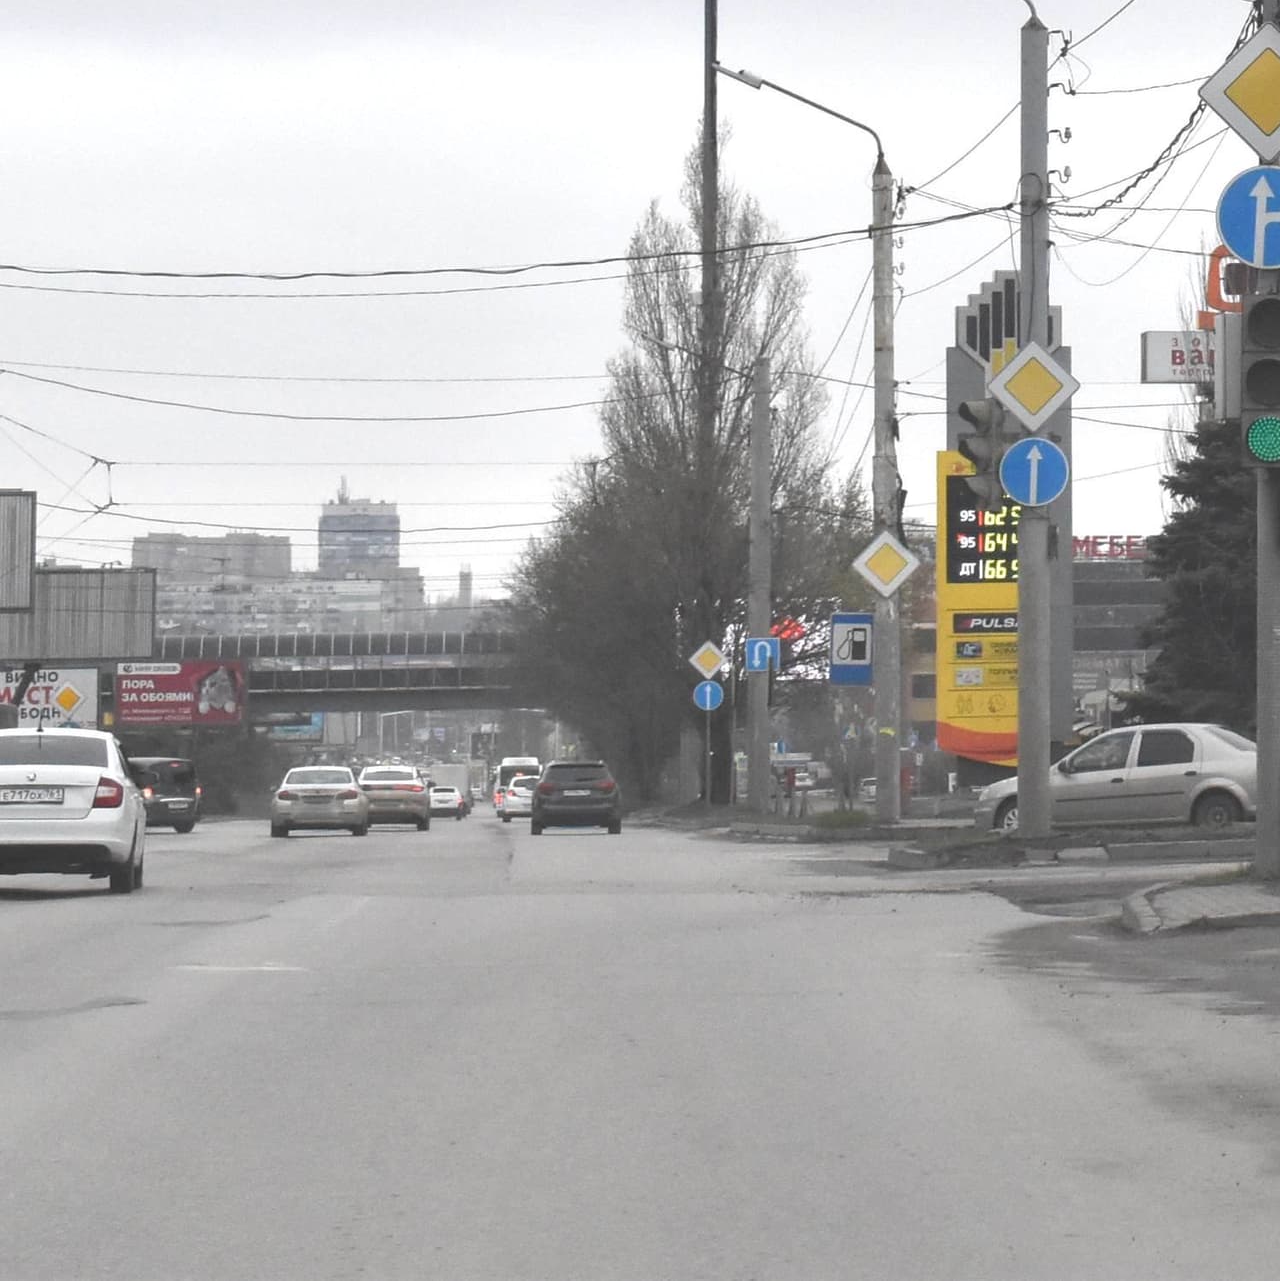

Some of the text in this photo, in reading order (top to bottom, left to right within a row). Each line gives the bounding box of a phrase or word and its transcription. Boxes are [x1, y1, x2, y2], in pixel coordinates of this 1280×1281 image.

[959, 510, 976, 522] 95
[959, 536, 976, 549] 95
[984, 533, 1007, 552] 64
[959, 562, 977, 576] ДТ
[984, 559, 1007, 580] 66
[970, 617, 1019, 629] PULS
[122, 680, 154, 689] ПОРА
[121, 693, 138, 702] ЗА
